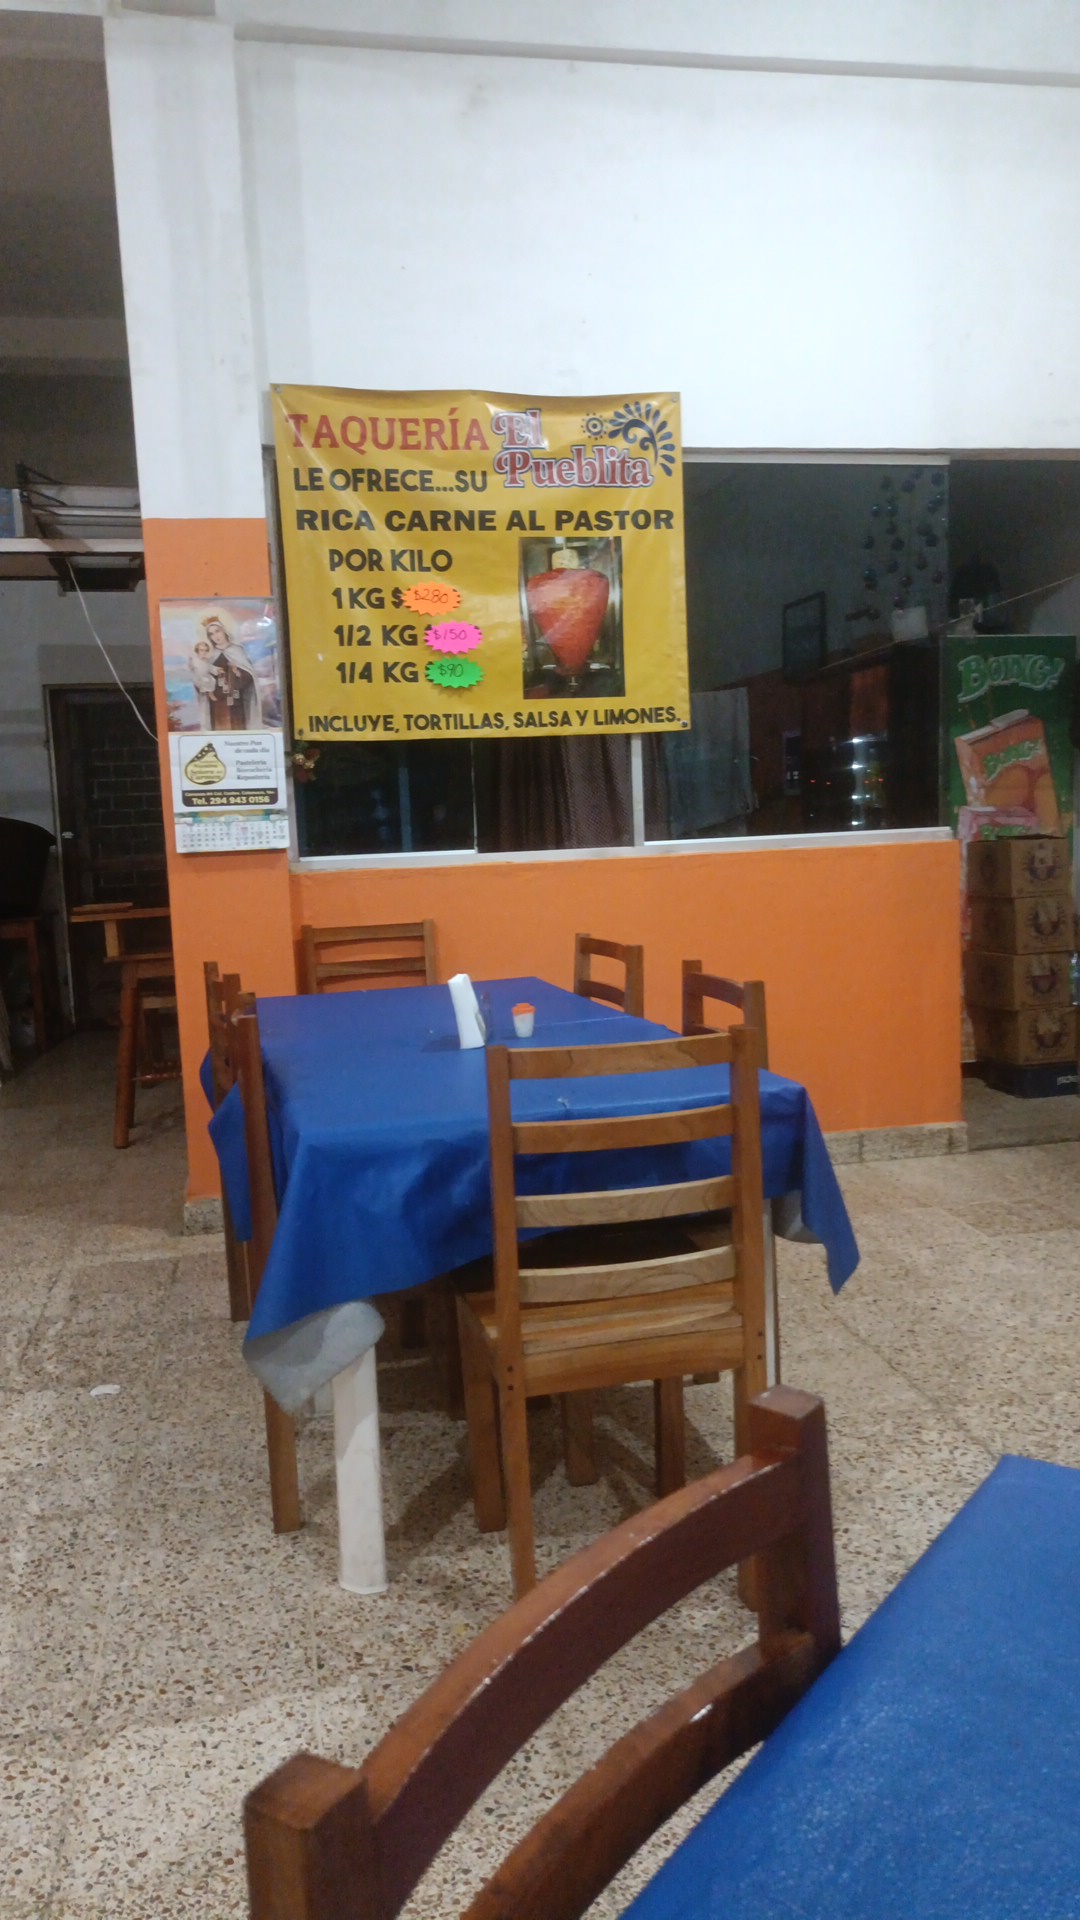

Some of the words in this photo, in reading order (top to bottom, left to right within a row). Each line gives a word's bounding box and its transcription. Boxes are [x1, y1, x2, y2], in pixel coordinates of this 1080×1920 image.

[286, 408, 490, 456] TAQUERÍA
[492, 407, 545, 449] El
[493, 444, 656, 489] Pueblita
[293, 467, 325, 491] LE
[296, 509, 376, 531] RICA
[385, 509, 497, 532] CARNE
[506, 509, 546, 532] AL
[555, 509, 675, 532] PASTOR
[328, 548, 385, 572] POR
[390, 548, 453, 573] KILO
[331, 587, 343, 609] 1
[348, 587, 386, 610] KG
[413, 588, 450, 604] $280
[333, 624, 372, 647] 1/2
[381, 624, 419, 647] KG
[432, 628, 468, 641] $150
[336, 661, 373, 684] 1/4
[383, 661, 420, 684] KG
[437, 663, 464, 678] $90
[957, 654, 1067, 704] BOING!
[308, 714, 400, 733] INCLUYE,
[403, 711, 510, 731] TORTILLAS,
[513, 709, 573, 729] SALSA
[575, 709, 589, 727] Y
[593, 705, 682, 726] LIMONES.
[191, 797, 208, 805] Tel.
[209, 796, 228, 805] 294
[229, 796, 247, 804] 943
